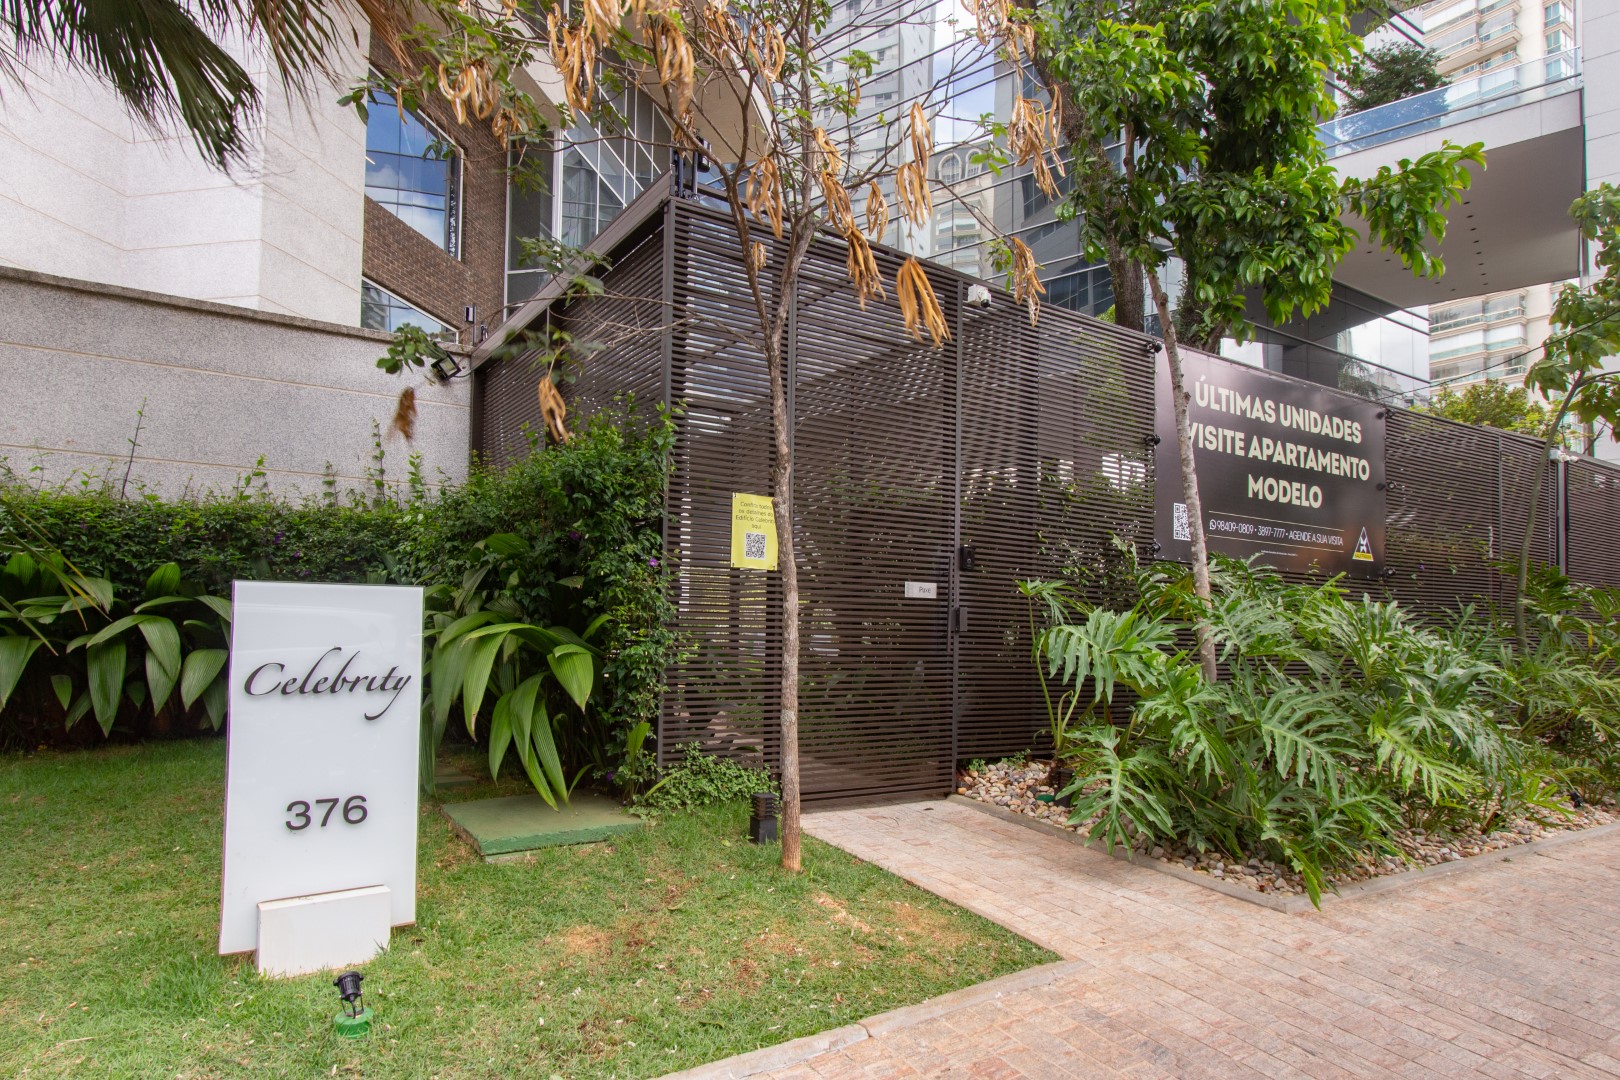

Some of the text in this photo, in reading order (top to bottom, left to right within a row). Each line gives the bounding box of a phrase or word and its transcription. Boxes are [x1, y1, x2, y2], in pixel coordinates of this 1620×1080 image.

[1194, 374, 1362, 444] ÚLTIMAS UNIDADES
[1247, 435, 1370, 481] APARTAMENTO
[1247, 473, 1323, 509] MODELO
[1257, 525, 1286, 539] 3897-7777
[1288, 530, 1312, 543] AGENDE
[1311, 533, 1317, 543] A
[1316, 533, 1328, 544] SUA
[1327, 535, 1344, 546] VISITA
[243, 646, 412, 721] Celebrity
[285, 794, 369, 831] 376
